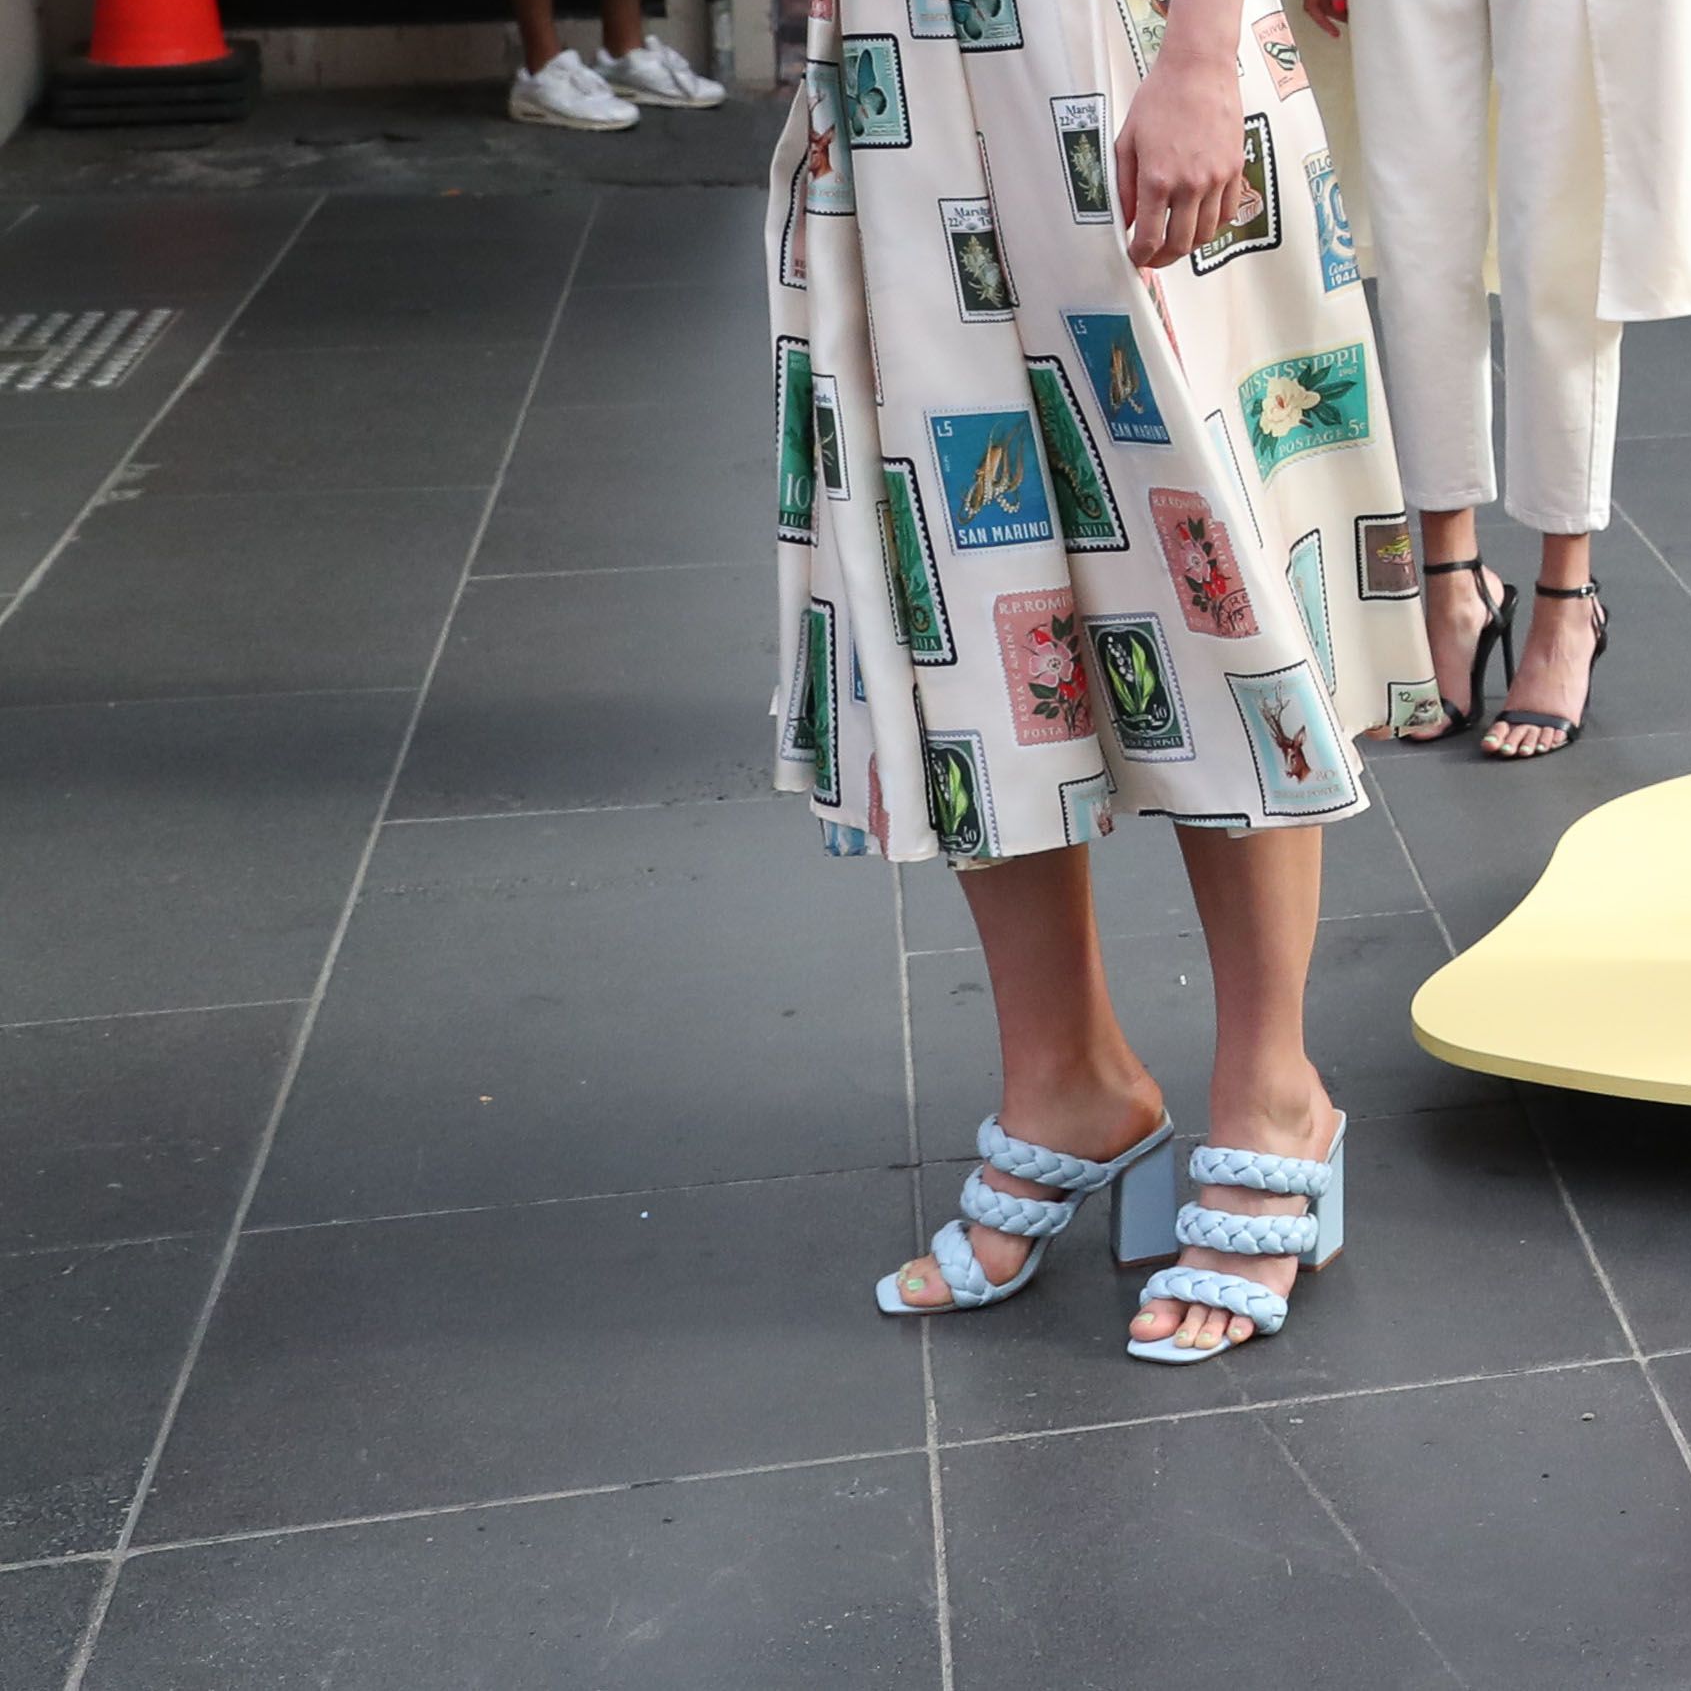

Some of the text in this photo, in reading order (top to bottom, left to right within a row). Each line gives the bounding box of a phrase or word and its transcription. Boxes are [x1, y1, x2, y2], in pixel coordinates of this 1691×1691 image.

[1240, 346, 1360, 399] MISSISSIPPI
[1111, 421, 1170, 441] SAN MARINO
[1278, 427, 1345, 458] POSTAGE
[786, 471, 811, 508] 10
[957, 520, 1050, 546] SAN MARINO
[1022, 726, 1064, 740] POSTA
